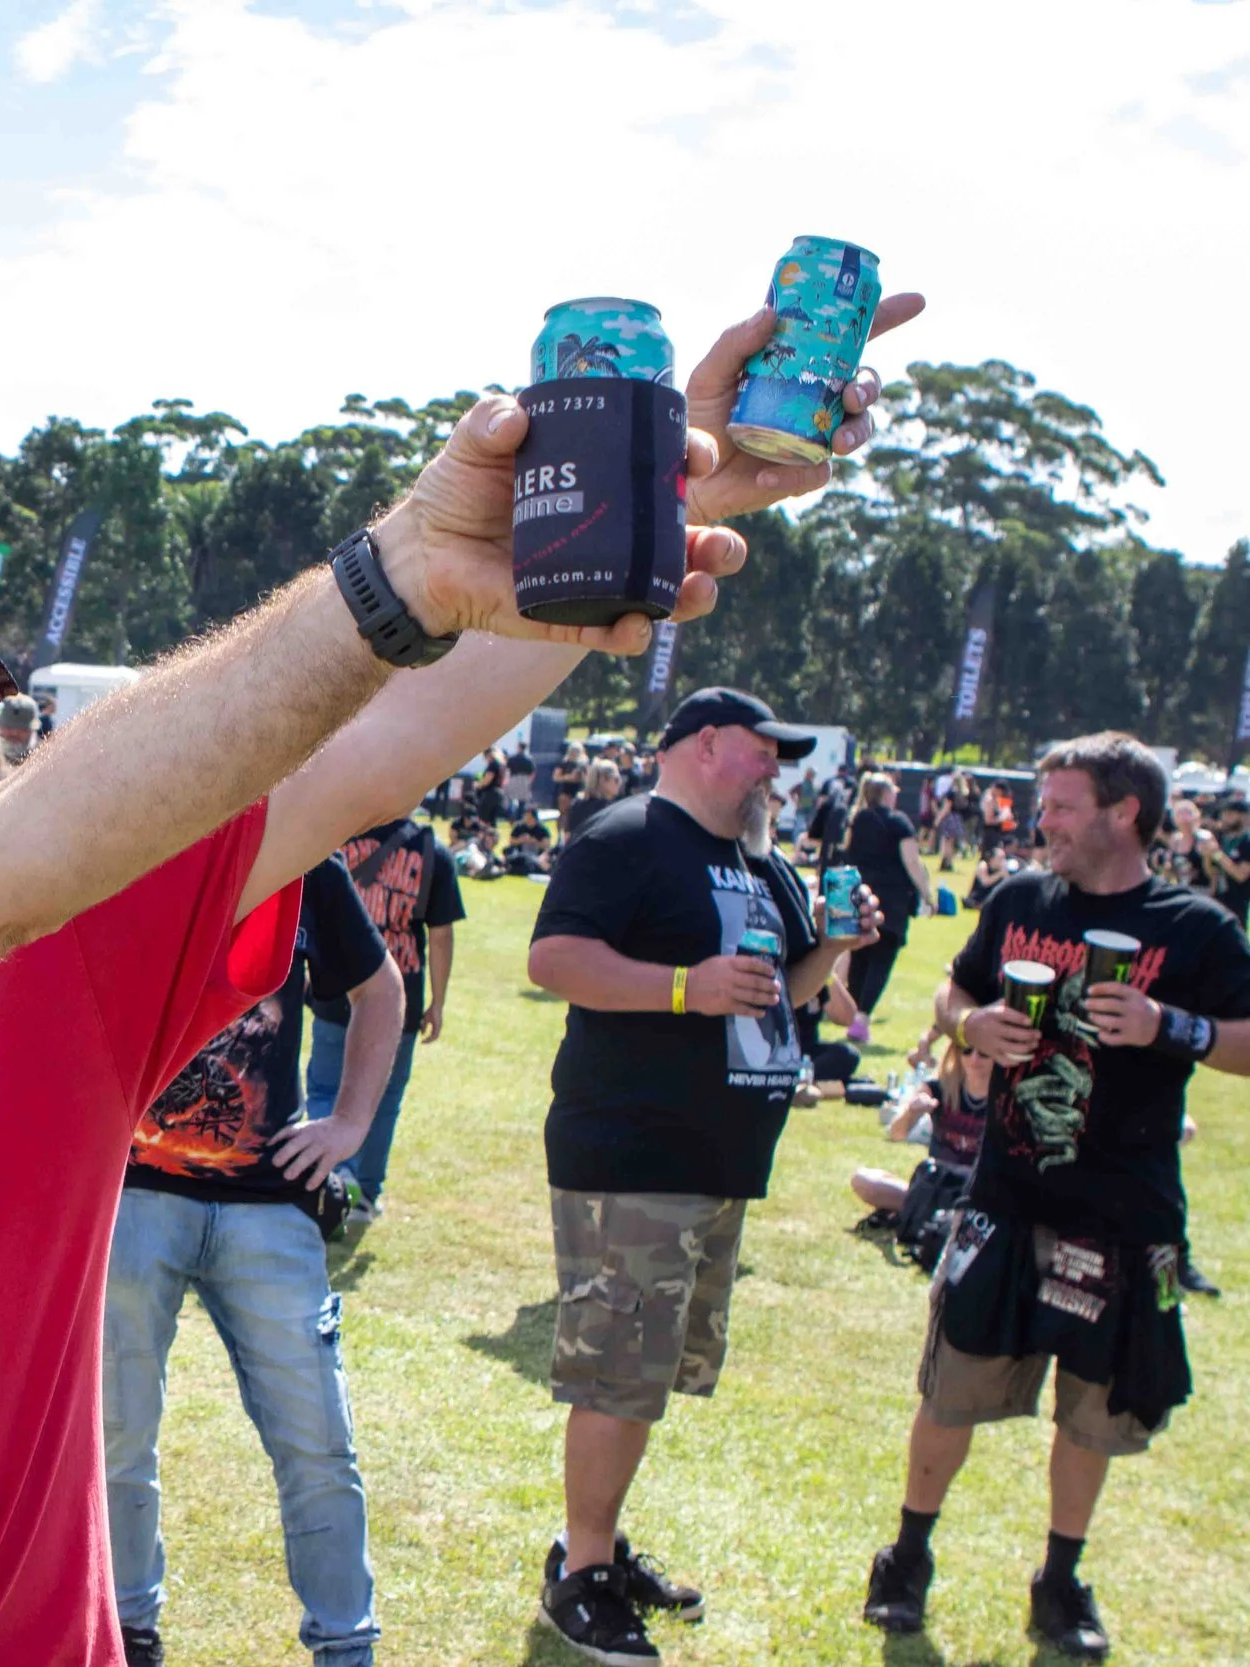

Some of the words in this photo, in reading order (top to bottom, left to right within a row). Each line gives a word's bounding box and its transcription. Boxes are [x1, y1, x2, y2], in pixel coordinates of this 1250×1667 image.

[563, 396, 605, 411] 7373
[514, 461, 577, 502] LERS
[512, 496, 573, 529] nline
[649, 620, 678, 693] TOILE
[954, 627, 987, 719] TOILETS
[728, 1071, 766, 1087] NEVER
